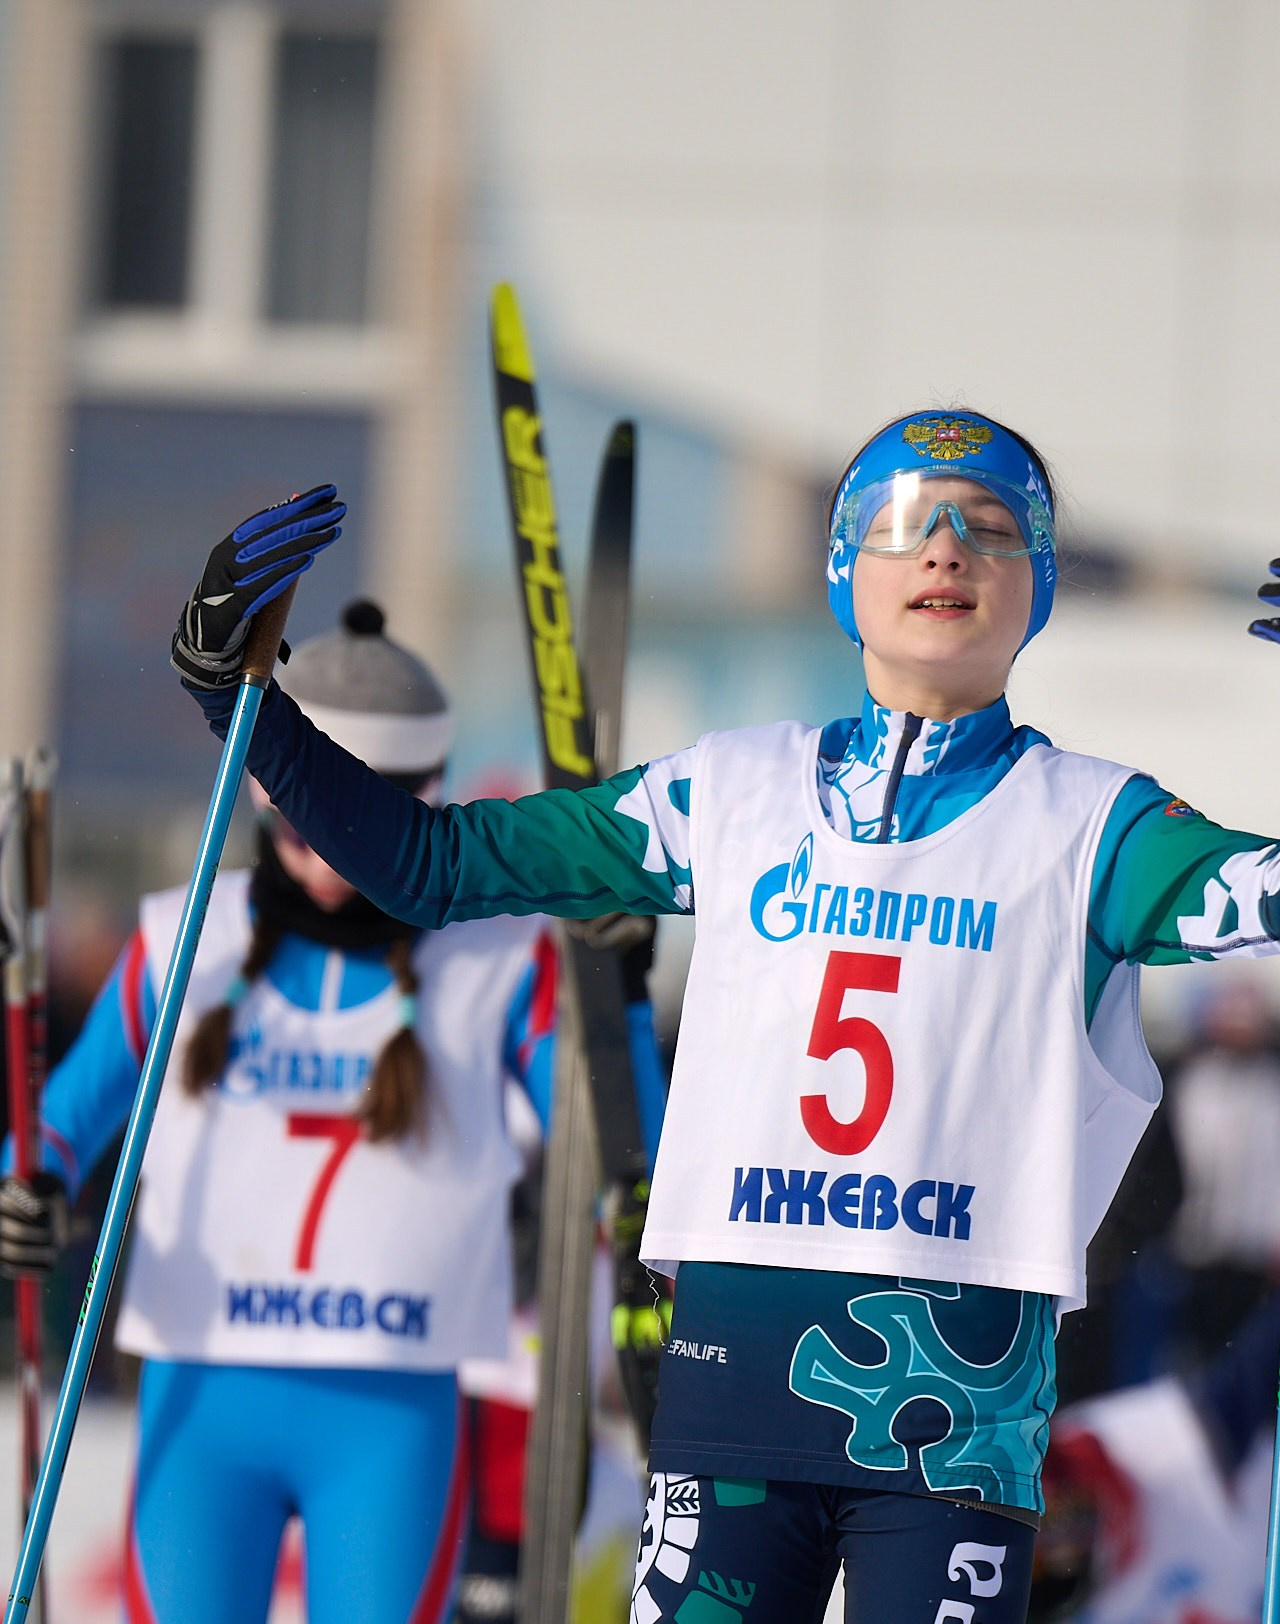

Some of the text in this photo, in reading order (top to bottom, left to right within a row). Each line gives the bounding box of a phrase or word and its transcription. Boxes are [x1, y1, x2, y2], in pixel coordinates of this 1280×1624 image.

[502, 404, 597, 779] FISCHER
[1040, 536, 1054, 584] RUSAL
[808, 883, 997, 952] ГАЗПРОМ
[800, 950, 902, 1156] 5
[286, 1111, 362, 1275] 7
[728, 1166, 976, 1241] ИЖЕВСК
[227, 1287, 432, 1341] ИЖЕВСК
